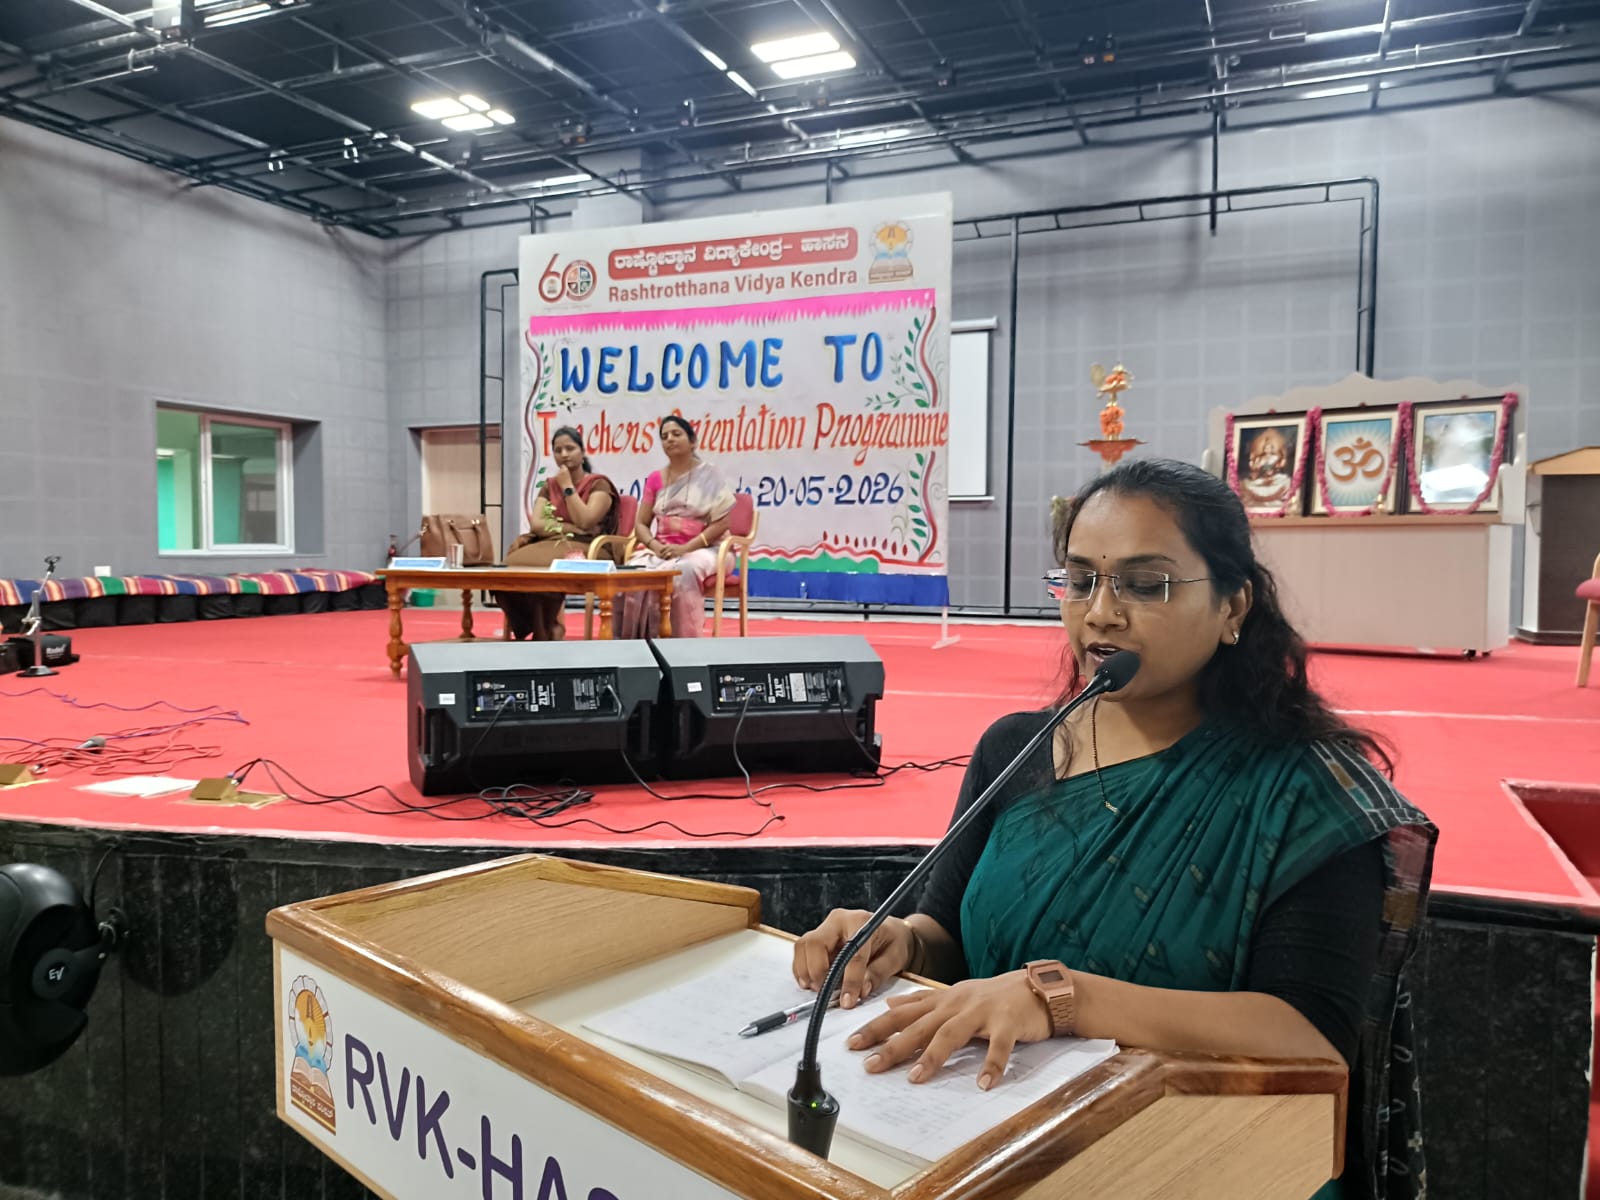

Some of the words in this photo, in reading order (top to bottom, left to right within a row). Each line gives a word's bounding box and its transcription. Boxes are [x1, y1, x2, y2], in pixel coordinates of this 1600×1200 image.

[801, 231, 849, 253] ಹಾಸನ
[608, 277, 730, 303] Rashtrotthana
[735, 272, 785, 294] Vidya
[791, 267, 858, 289] Kendra
[559, 337, 784, 394] WELCOME
[824, 332, 884, 384] TO
[536, 409, 663, 457] Tchers'
[671, 403, 807, 453] rientation
[813, 402, 949, 467] Programme
